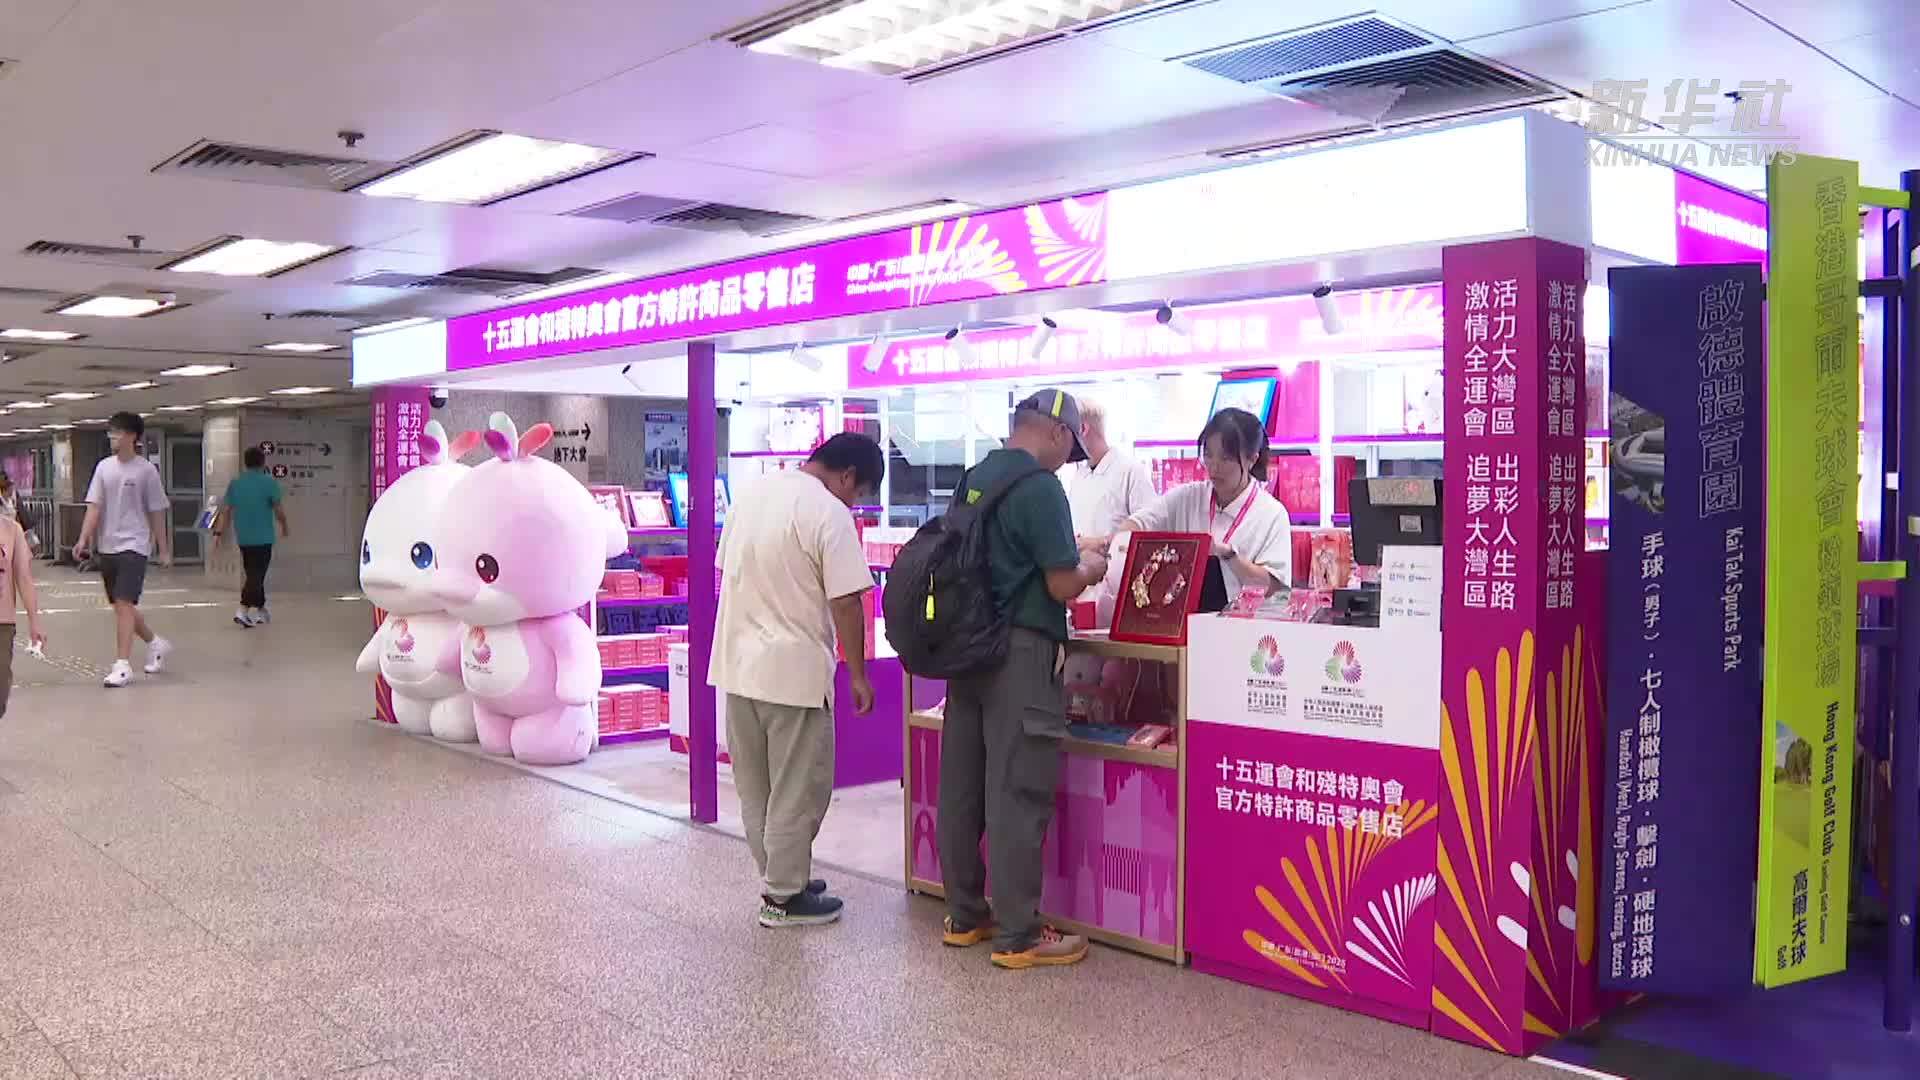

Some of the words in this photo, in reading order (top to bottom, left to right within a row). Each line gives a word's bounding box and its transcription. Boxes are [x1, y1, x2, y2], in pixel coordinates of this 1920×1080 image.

[1463, 281, 1490, 437] 激情全運會
[1492, 279, 1518, 435] 活力大灣區
[1547, 280, 1562, 437] 激情全運會
[1562, 284, 1577, 437] 活力大灣區
[1697, 280, 1745, 519] 啟德體育園
[1464, 453, 1491, 608] 追夢大灣區
[1490, 453, 1519, 610] 出彩人生路
[1546, 453, 1562, 608] 追夢大灣區
[1560, 453, 1577, 608] 出彩人生路
[1725, 527, 1744, 552] Kai
[1725, 554, 1744, 582] Tak
[1720, 583, 1743, 633] Sports
[1723, 634, 1741, 672] Park
[1215, 754, 1404, 807] 十五運會和殘特奧會
[1822, 744, 1838, 784] Kong
[1823, 701, 1839, 743] Hong
[1215, 785, 1404, 840] 官方特許商品零售店
